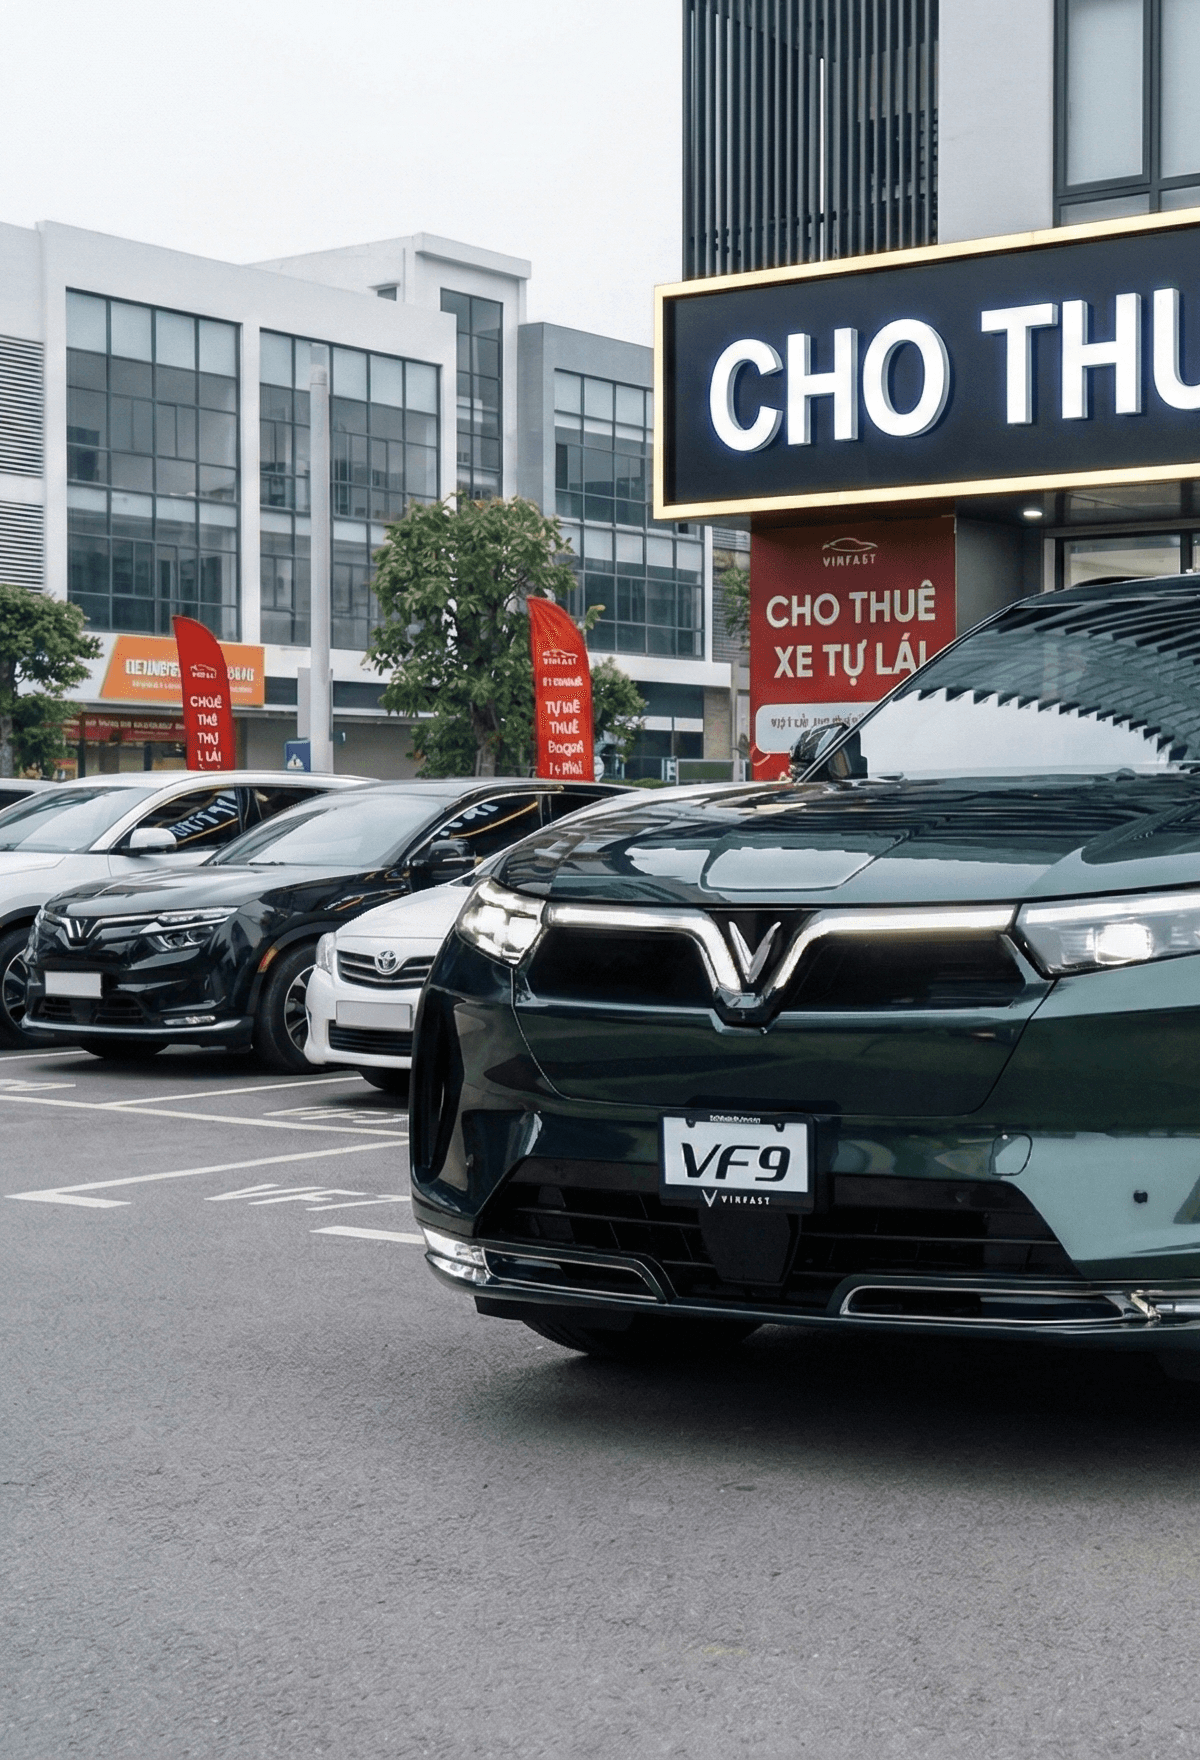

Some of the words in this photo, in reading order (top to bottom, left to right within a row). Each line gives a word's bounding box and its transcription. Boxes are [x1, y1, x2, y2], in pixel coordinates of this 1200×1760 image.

[710, 319, 951, 453] CHO
[766, 593, 840, 628] CHO
[849, 579, 936, 624] THUÊ
[773, 644, 814, 679] XE
[822, 639, 868, 687] TỰ
[875, 632, 927, 676] LÁI
[680, 1142, 791, 1183] VF9
